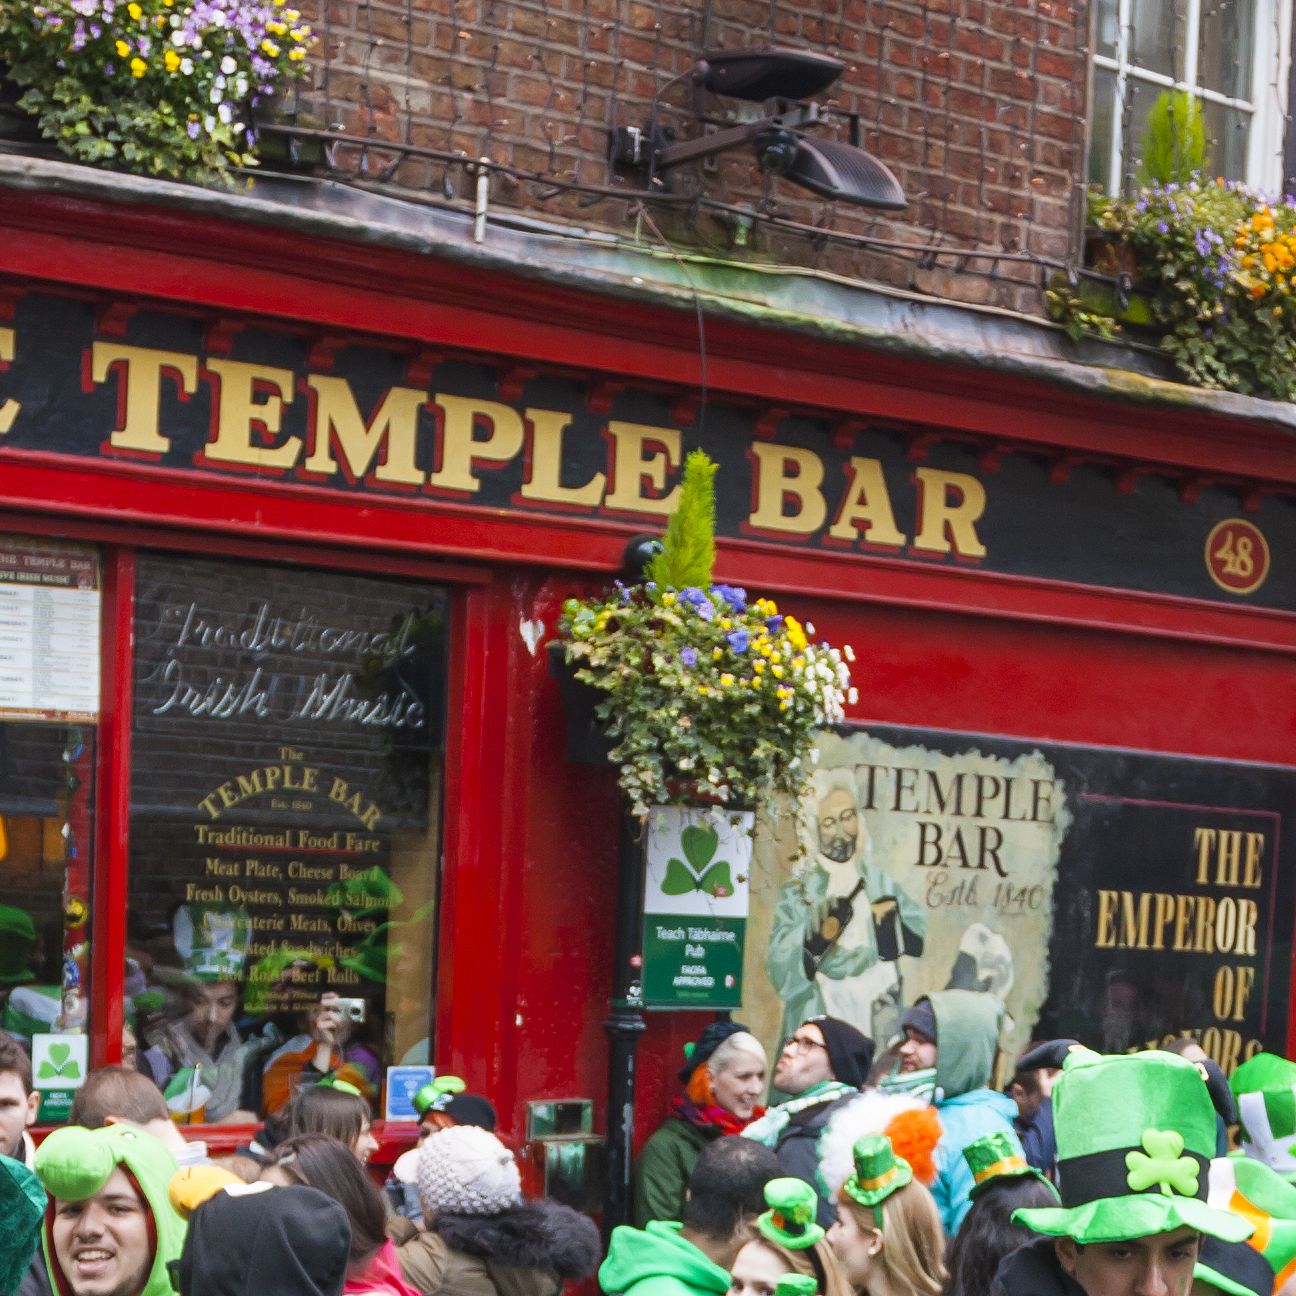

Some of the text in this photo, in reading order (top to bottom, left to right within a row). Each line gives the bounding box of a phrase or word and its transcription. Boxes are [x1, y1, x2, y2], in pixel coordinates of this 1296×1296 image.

[93, 341, 684, 515] TEMPLE
[750, 441, 988, 558] BAR
[23, 555, 66, 569] TEMPLE
[1215, 530, 1254, 577] 48
[278, 746, 304, 761] The
[197, 765, 383, 832] TEMPLE BAR
[855, 763, 1056, 824] TEMPLE
[194, 824, 381, 852] Traditional Food Fare
[914, 820, 1010, 879] BAR
[205, 857, 240, 876] Meat
[245, 859, 284, 881] Plate,
[287, 860, 334, 880] Cheese
[1193, 826, 1265, 889] THE
[186, 883, 224, 902] Fresh
[228, 885, 283, 907] Oysters,
[287, 887, 342, 906] Smoked
[994, 883, 1046, 910] 1840
[290, 913, 332, 933] Meats,
[336, 916, 378, 933] Olives
[655, 925, 685, 940] Teach
[1094, 888, 1258, 957] EMPEROR
[685, 943, 706, 958] Pub
[327, 968, 361, 985] Rolls
[672, 976, 716, 988] APPROVED
[1213, 965, 1255, 1022] OF
